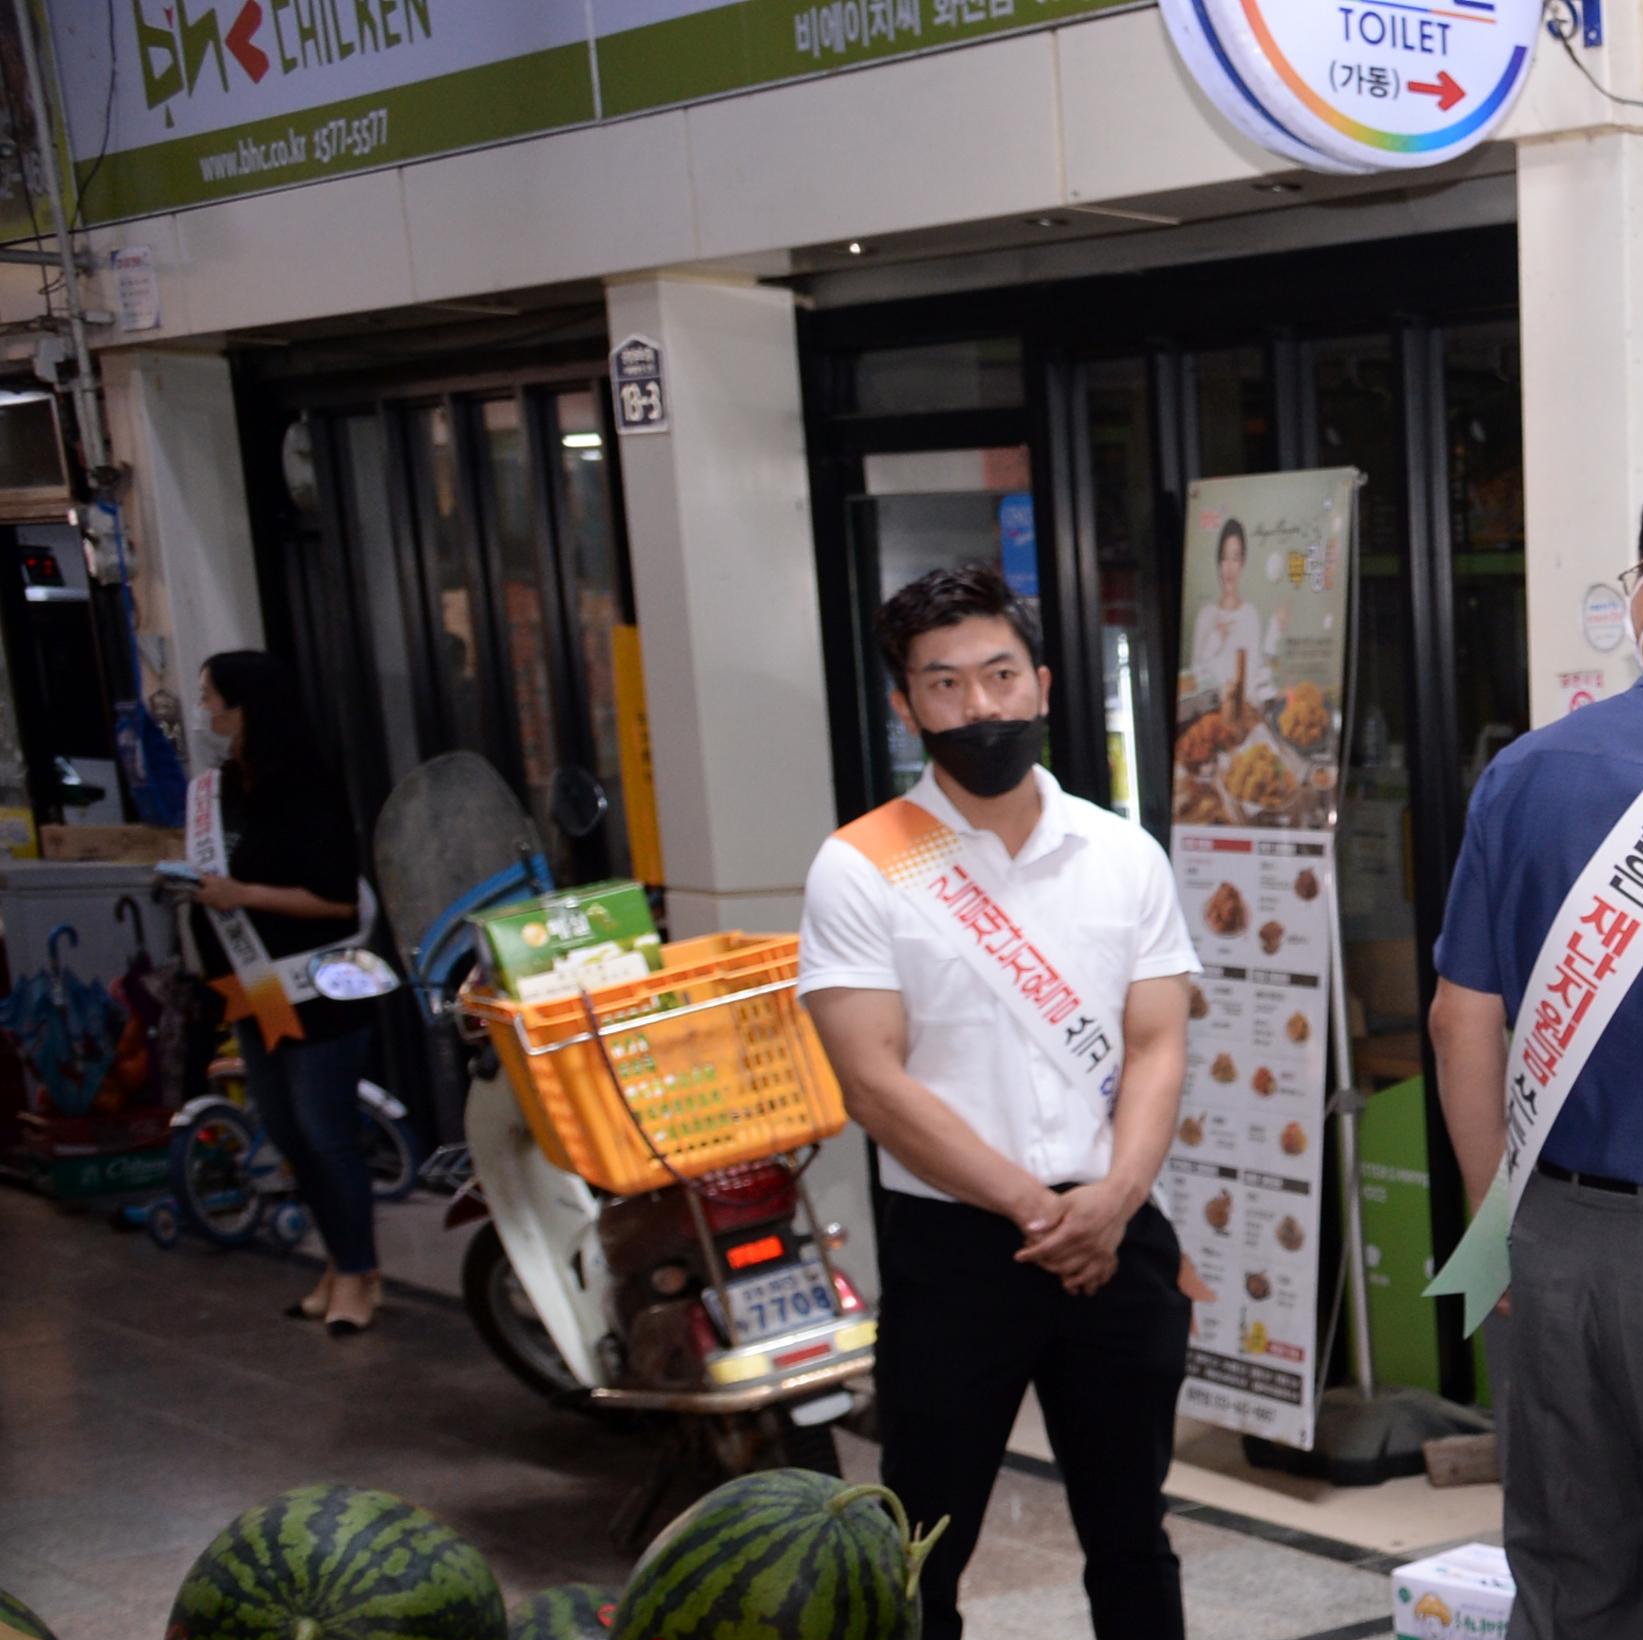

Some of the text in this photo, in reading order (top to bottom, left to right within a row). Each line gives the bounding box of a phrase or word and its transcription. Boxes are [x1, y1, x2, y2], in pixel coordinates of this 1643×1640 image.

[793, 2, 923, 59] 비에이치씨
[1338, 7, 1452, 56] TOILET
[1329, 59, 1400, 100] (가동)
[200, 107, 389, 182] www.bhc.co.kr 1577-5577
[928, 862, 1113, 1075] 긴급재난지원금 쓰고
[1519, 894, 1642, 1088] 재난지원금
